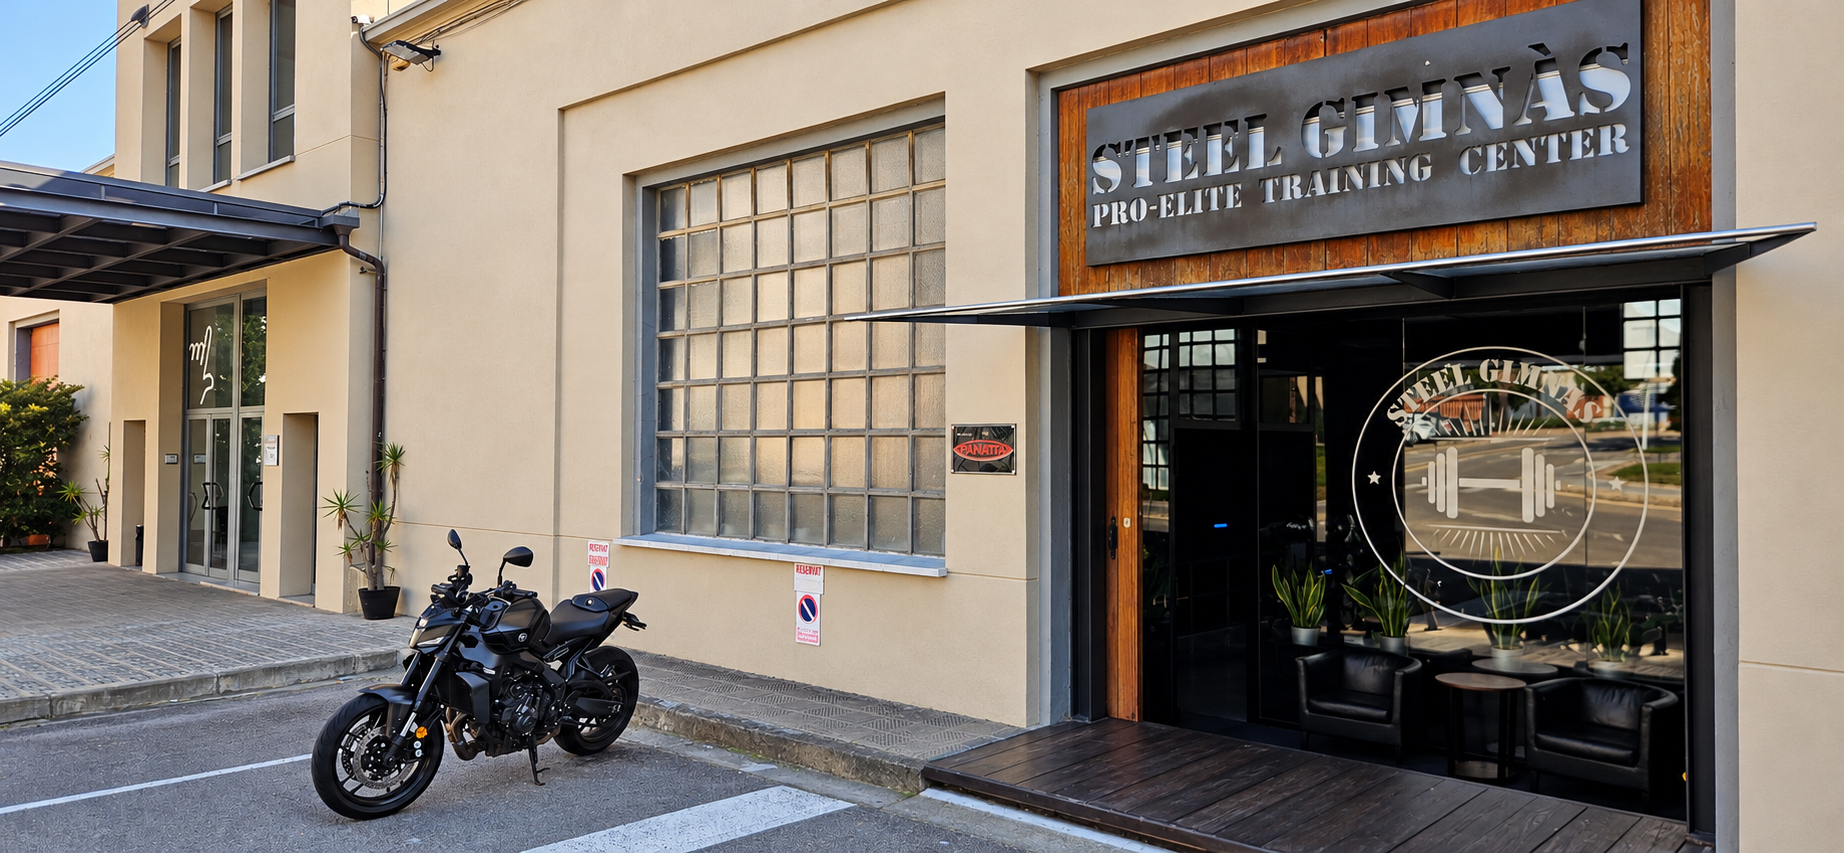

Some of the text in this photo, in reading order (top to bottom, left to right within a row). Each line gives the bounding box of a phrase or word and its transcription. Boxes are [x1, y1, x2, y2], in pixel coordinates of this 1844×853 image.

[1091, 42, 1632, 195] STEEL GIMNÀS
[1091, 123, 1630, 228] PRO-ELITE TRAINING CENTER
[1386, 362, 1473, 428] STEEL
[960, 442, 1006, 456] PANATTA
